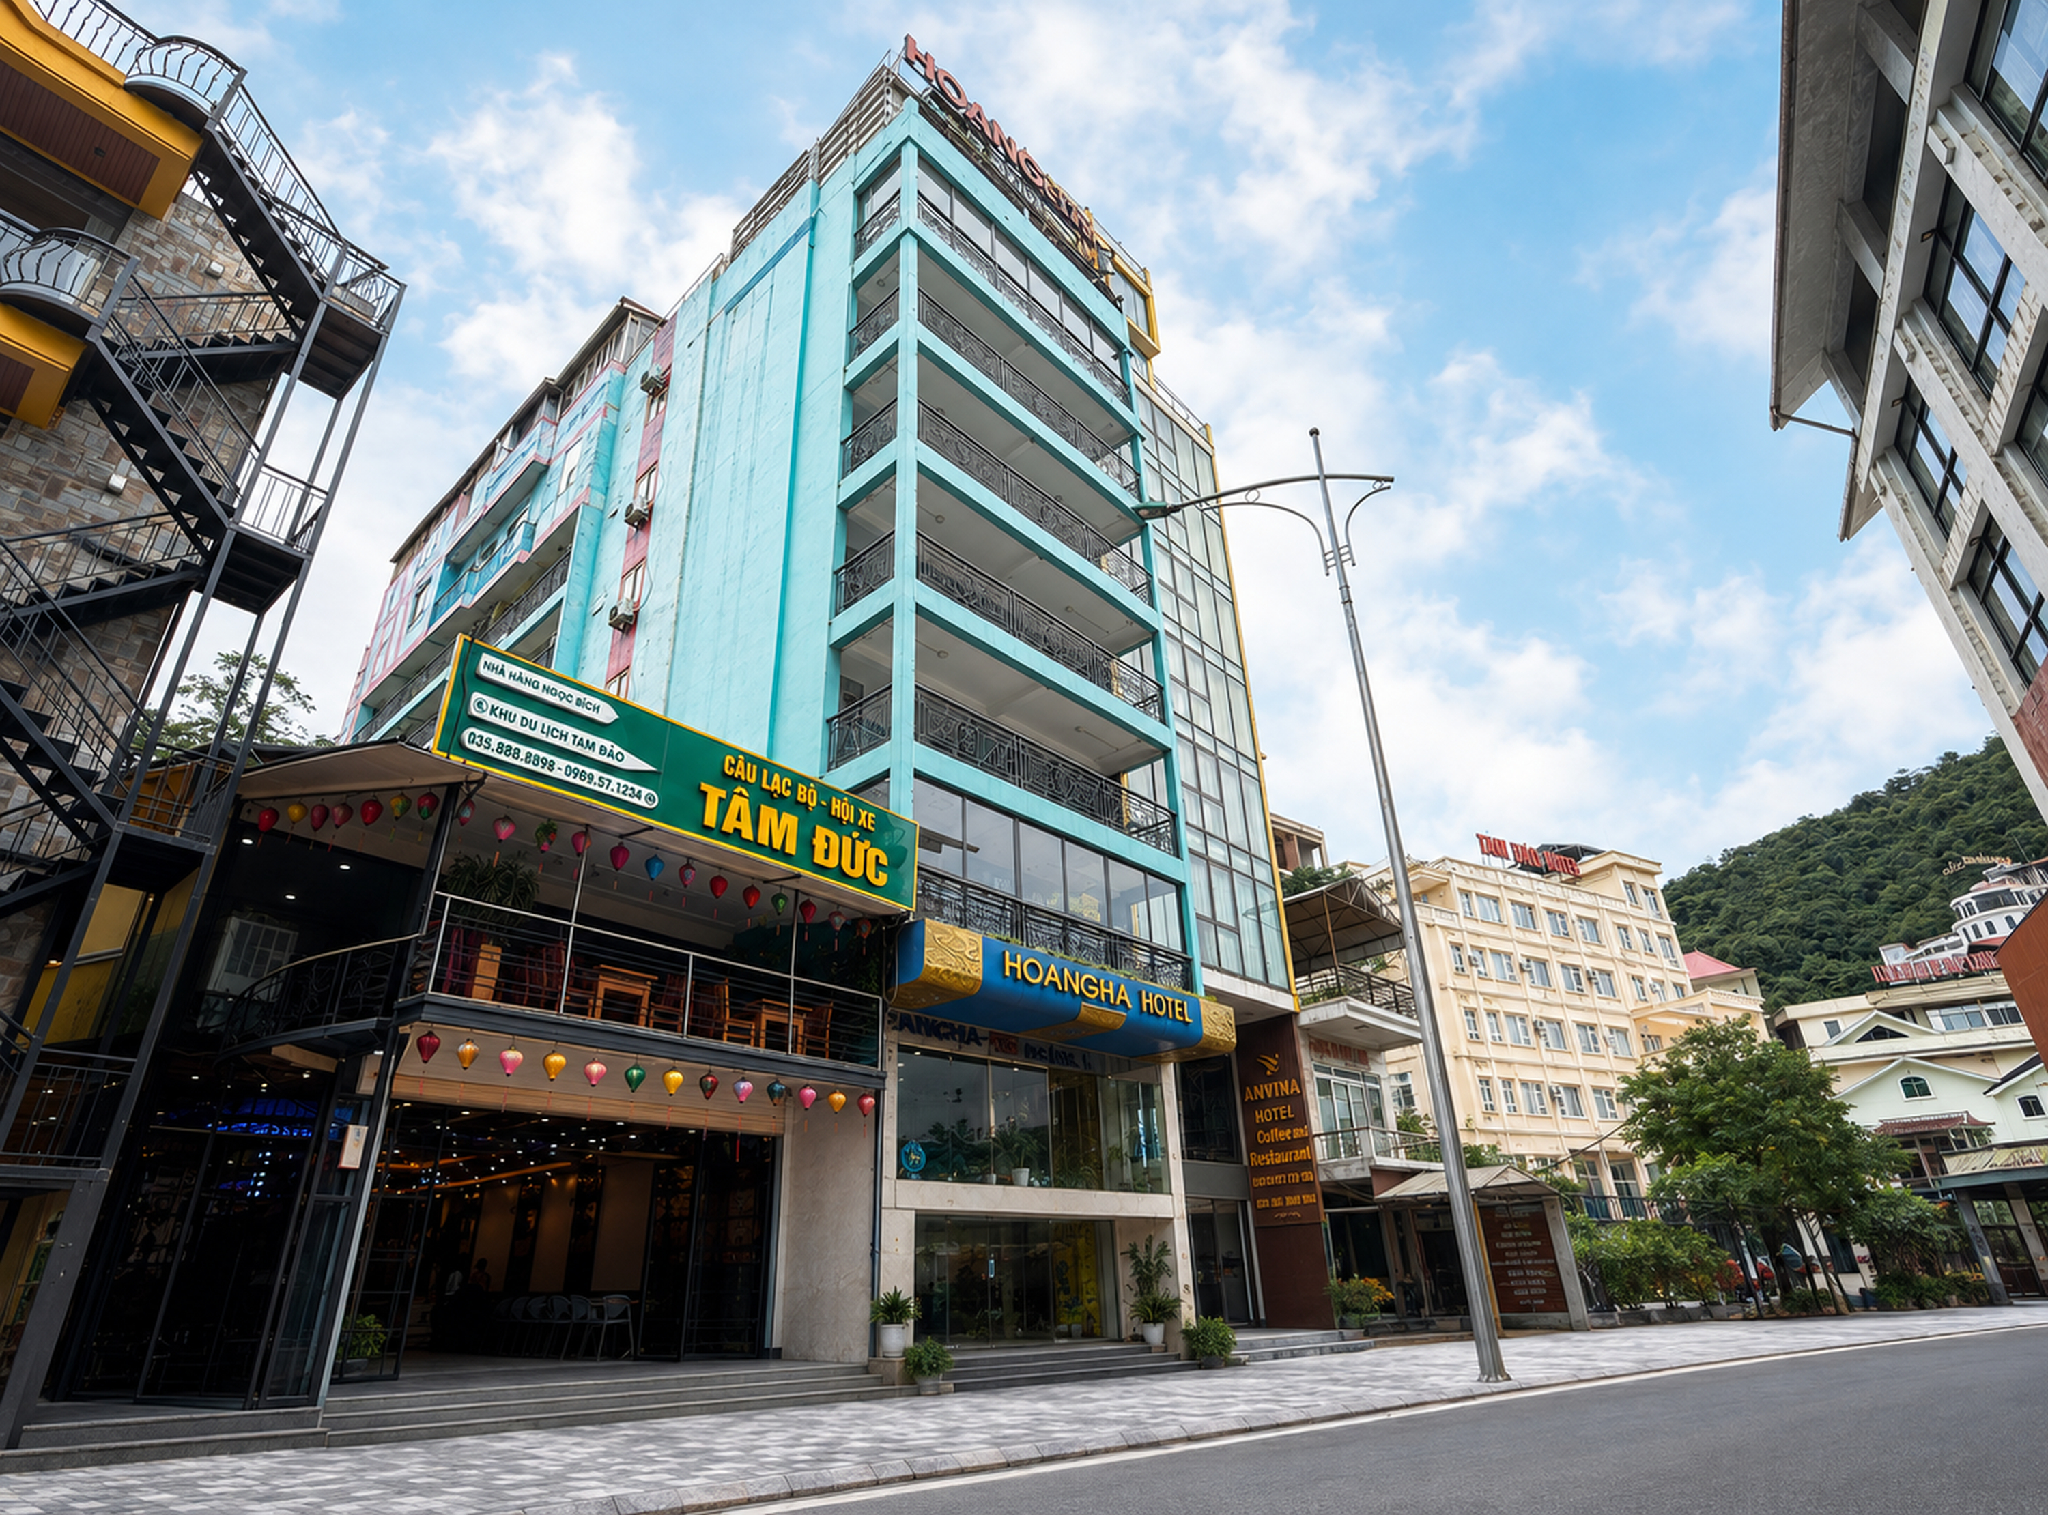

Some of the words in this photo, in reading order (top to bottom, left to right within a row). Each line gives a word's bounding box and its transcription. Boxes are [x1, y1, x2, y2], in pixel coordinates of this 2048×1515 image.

[483, 660, 505, 677] NHÀ
[508, 672, 540, 690] HÀNG
[541, 684, 574, 704] NGỌC
[489, 704, 517, 724] KHU
[520, 716, 538, 731] DU
[541, 722, 568, 743] LỊCH
[571, 734, 596, 754] TAM
[724, 754, 758, 784] CÂU
[761, 768, 792, 798] LẠC
[796, 783, 818, 811] BỘ
[831, 796, 854, 824] HỘI
[858, 808, 876, 832] XE
[700, 782, 799, 856] TÂM
[812, 824, 888, 887] ĐỨC
[1003, 950, 1133, 1009] HOANGHA
[1140, 989, 1193, 1023] HOTEL
[1244, 1078, 1301, 1102] ANVINA
[1254, 1104, 1294, 1124] HOTEL
